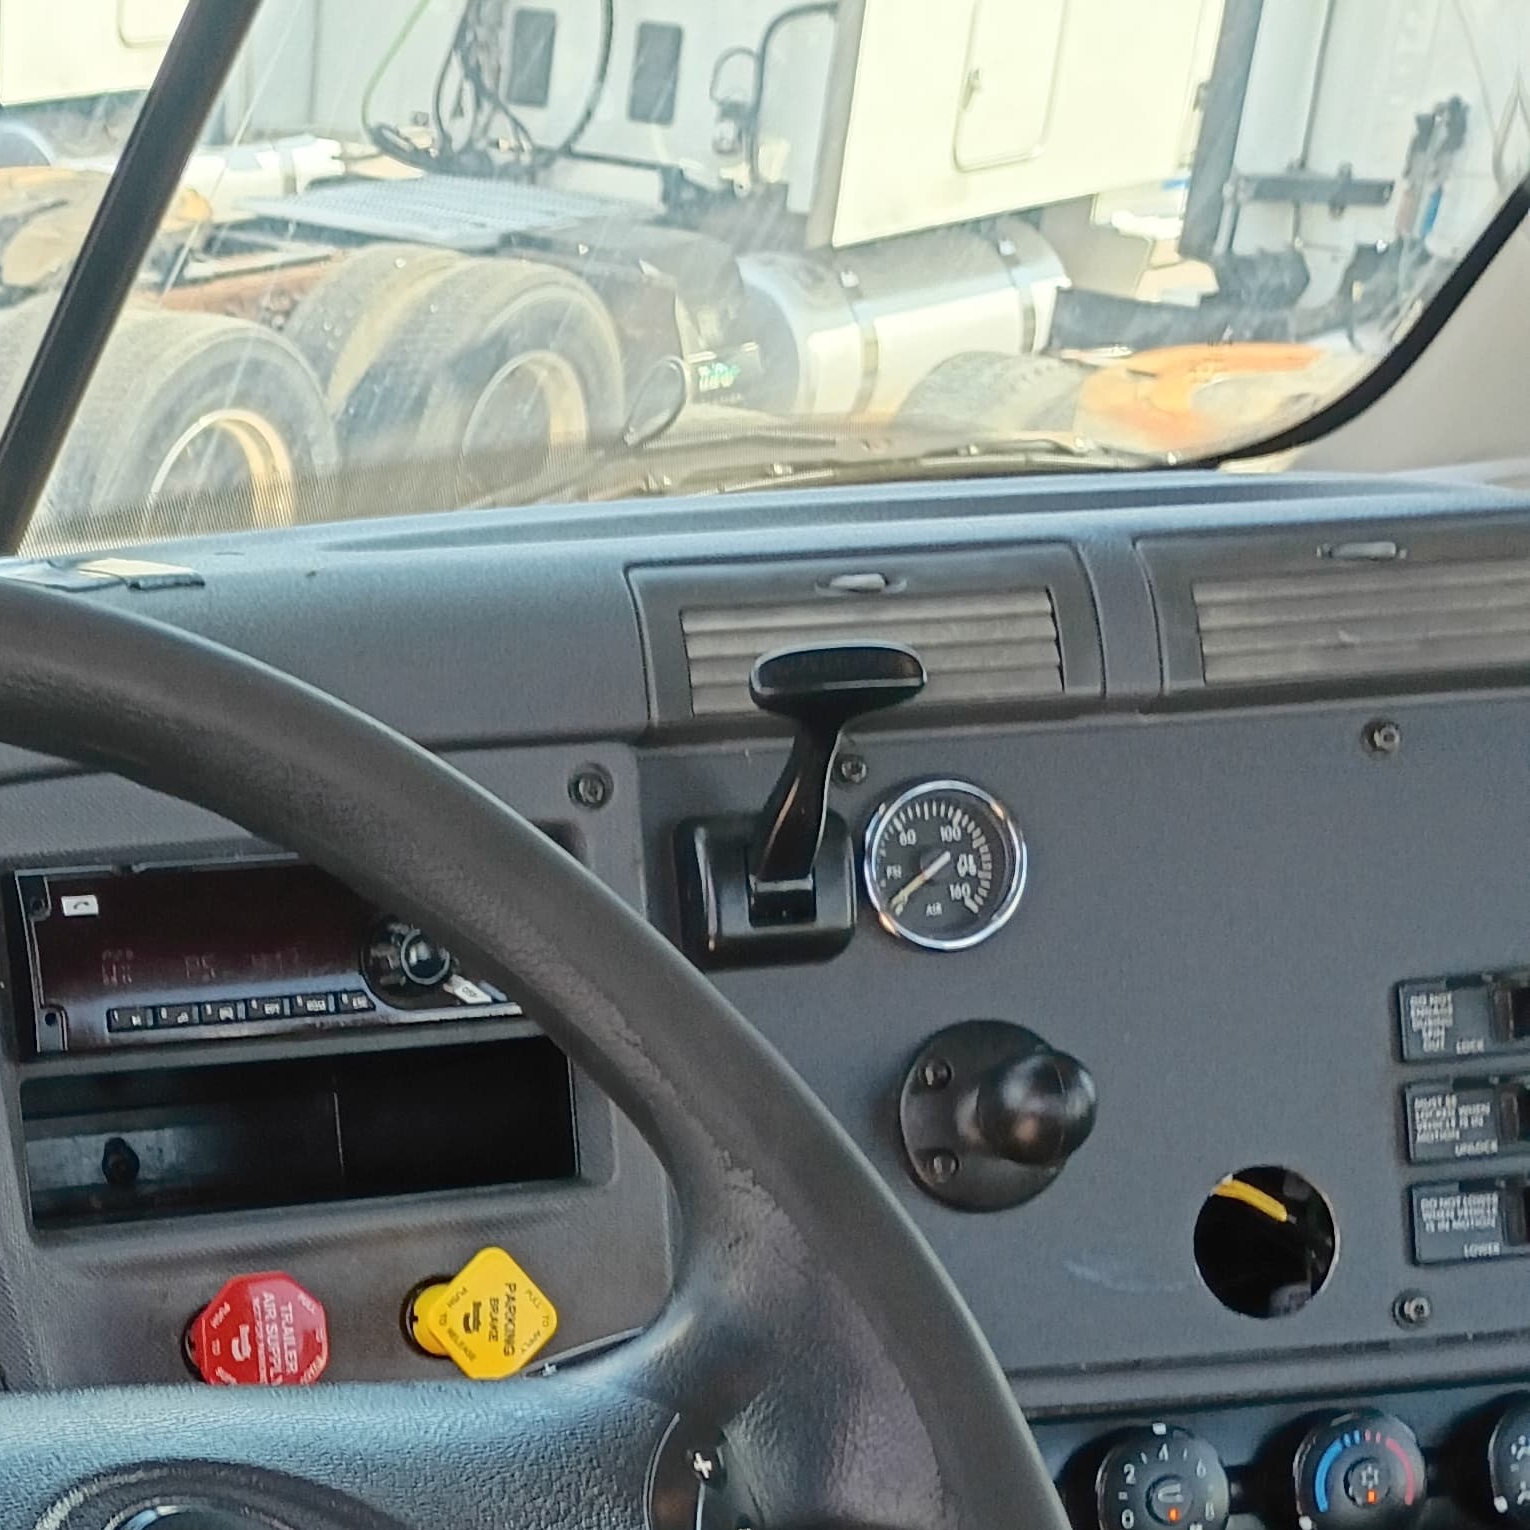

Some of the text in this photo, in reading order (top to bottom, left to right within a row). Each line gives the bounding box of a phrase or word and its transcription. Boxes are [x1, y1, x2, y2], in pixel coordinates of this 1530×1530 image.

[940, 825, 961, 843] 100
[950, 882, 971, 901] 160
[925, 902, 943, 917] AIR
[262, 1291, 277, 1321] AIR
[439, 1313, 447, 1326] TO
[489, 1297, 500, 1342] BRAKE
[503, 1282, 517, 1356] PARKING
[541, 1314, 550, 1328] TO
[280, 1302, 299, 1375] TRAILER
[1158, 1442, 1169, 1462] 4
[1123, 1463, 1136, 1485] 2
[1196, 1458, 1207, 1479] 6
[1121, 1509, 1135, 1530] 0
